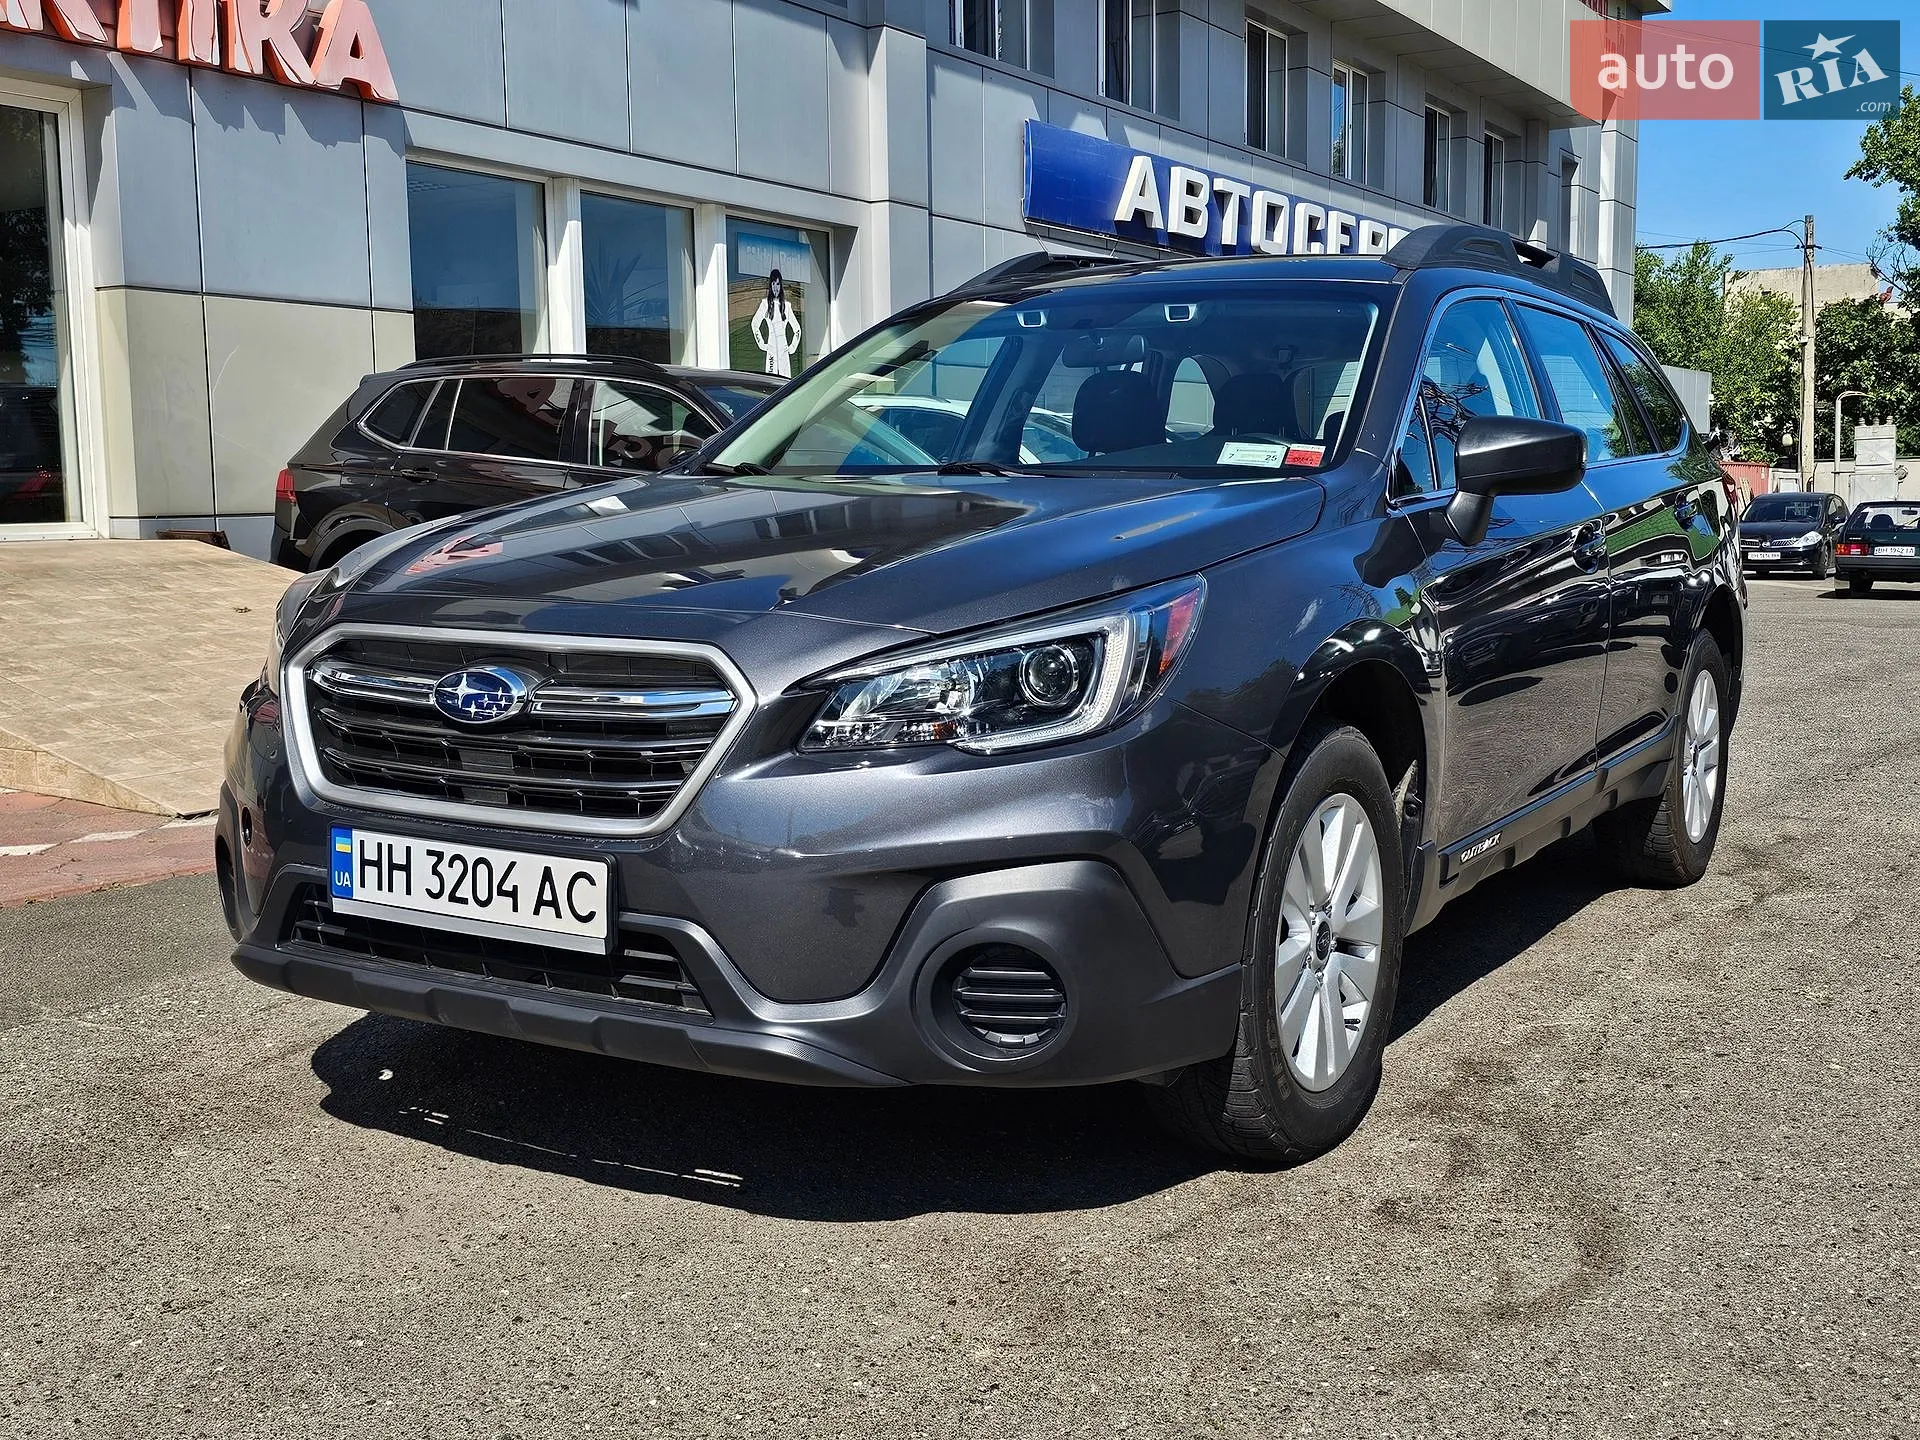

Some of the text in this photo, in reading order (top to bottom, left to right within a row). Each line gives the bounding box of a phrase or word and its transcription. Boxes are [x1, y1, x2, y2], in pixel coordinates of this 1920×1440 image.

[335, 871, 351, 888] UA
[360, 840, 597, 924] HH 3204 AC
